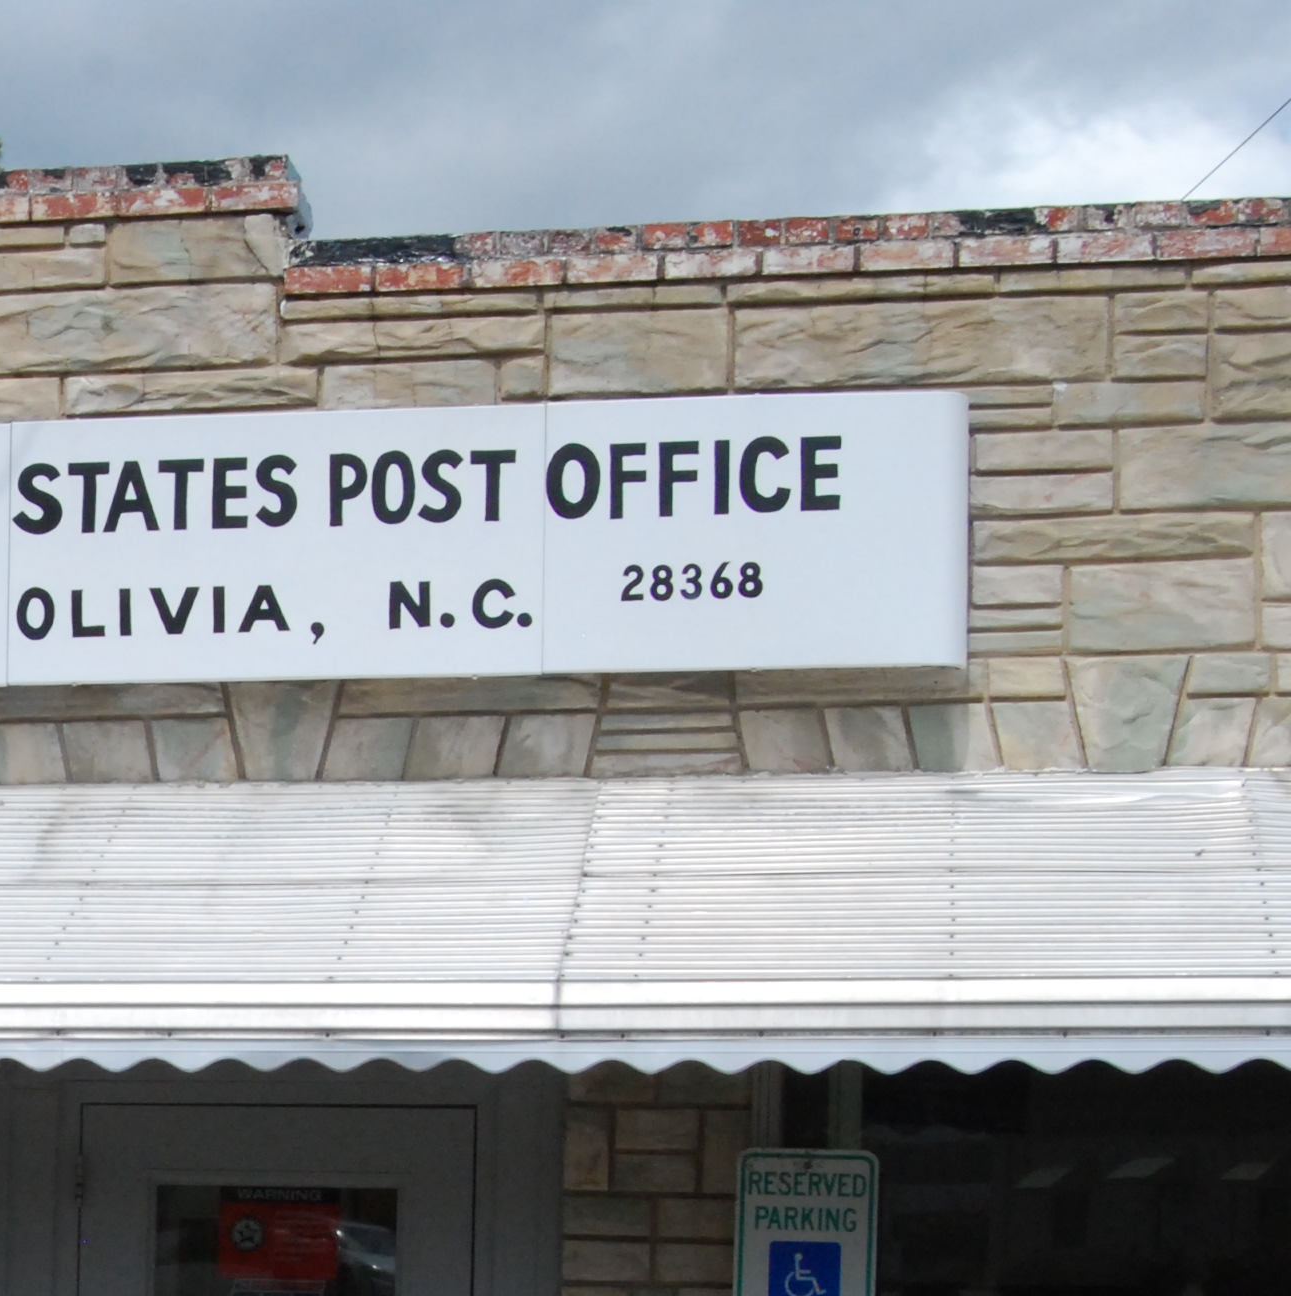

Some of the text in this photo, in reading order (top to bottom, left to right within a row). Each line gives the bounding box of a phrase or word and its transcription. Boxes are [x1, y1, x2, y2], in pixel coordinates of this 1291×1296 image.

[12, 454, 298, 535] STATES
[329, 449, 517, 527] POST
[545, 435, 842, 519] OFFICE
[16, 562, 763, 645] OLIVIA, N.C. 28368
[237, 1188, 323, 1201] WARNING
[747, 1171, 867, 1198] RESERVED
[754, 1206, 857, 1232] PARKING
